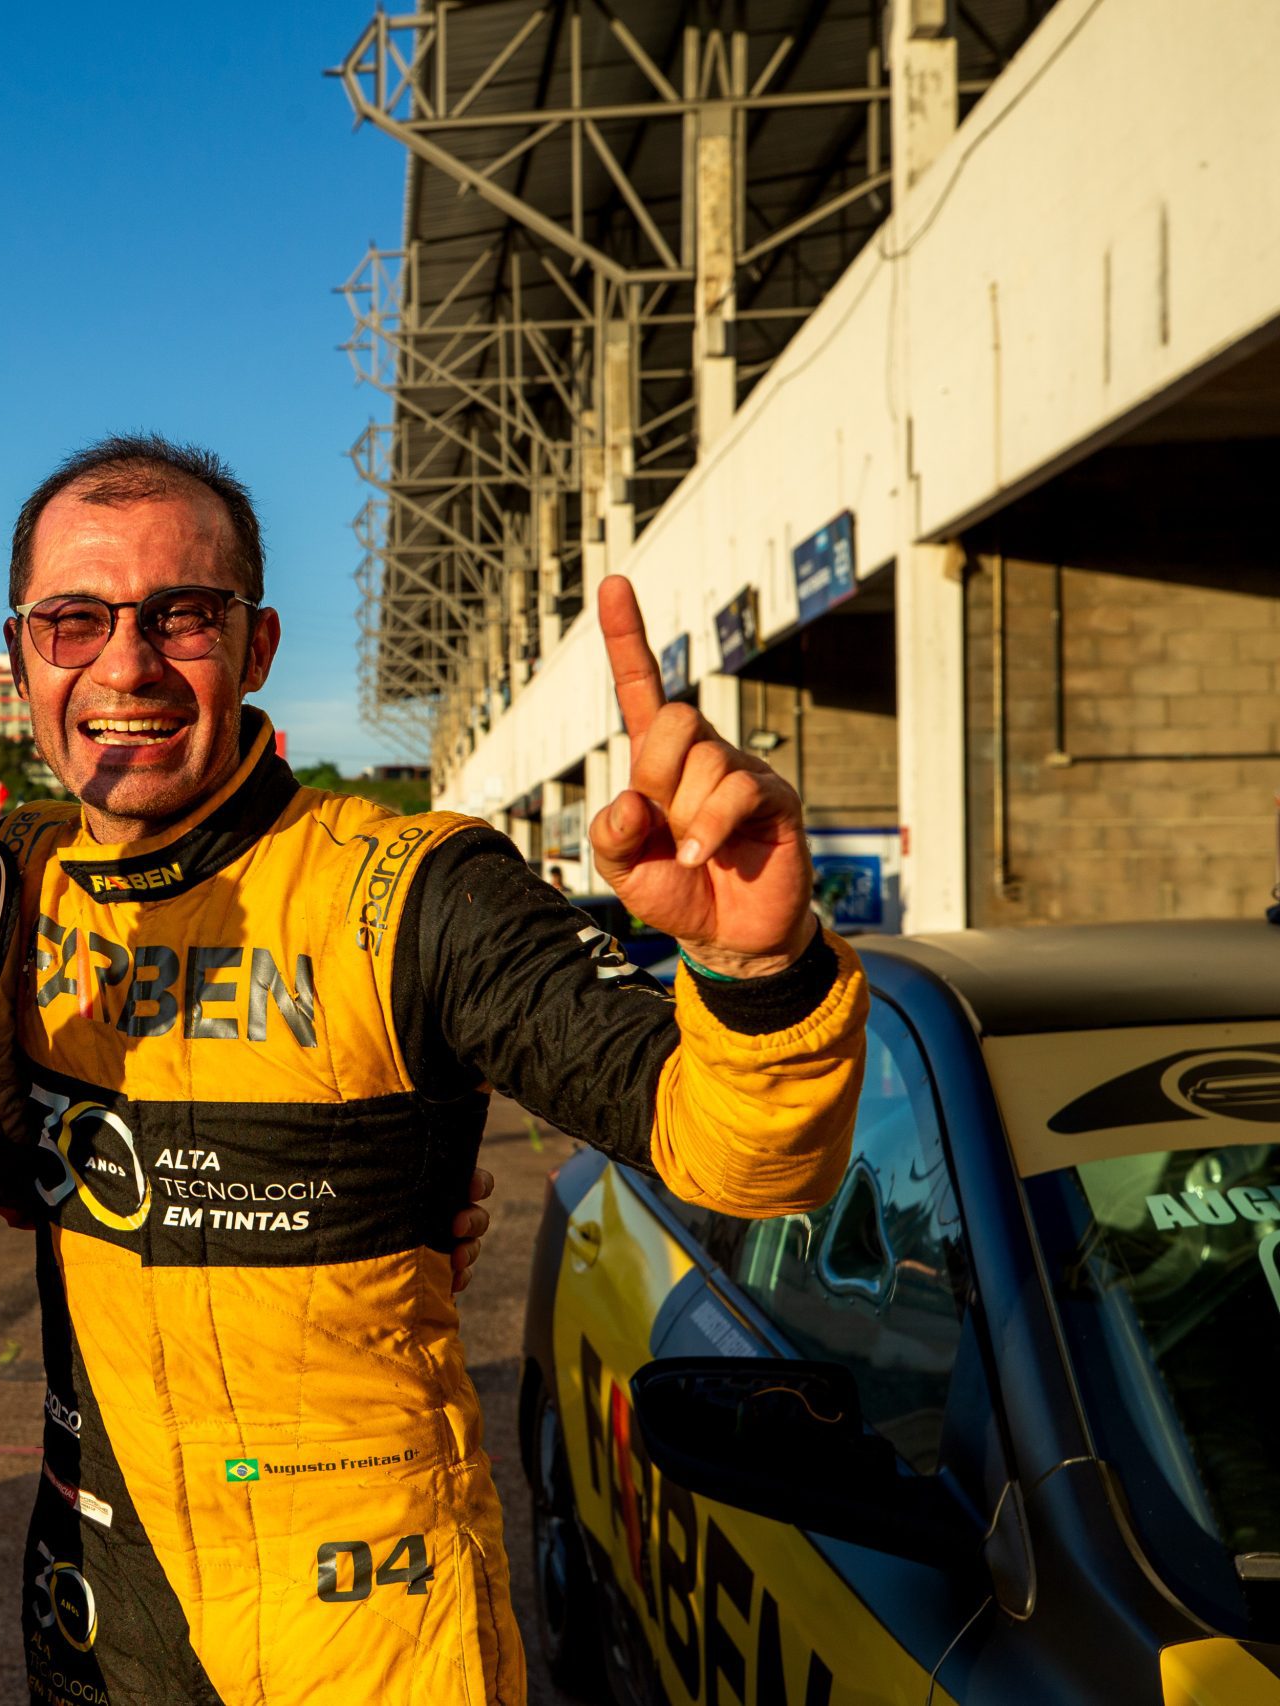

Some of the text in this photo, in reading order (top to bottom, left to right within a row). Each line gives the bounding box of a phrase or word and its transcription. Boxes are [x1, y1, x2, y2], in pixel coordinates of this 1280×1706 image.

[90, 862, 184, 892] FARBEN
[356, 827, 433, 957] sparco
[85, 1156, 127, 1177] ANOS
[155, 1149, 220, 1171] ALTA
[158, 1177, 337, 1201] TECNOLOGIA
[163, 1206, 310, 1231] EM TINTAS
[1145, 1185, 1280, 1231] AUG
[264, 1462, 336, 1476] Augusto
[340, 1454, 400, 1470] Freitas
[317, 1533, 435, 1602] 04
